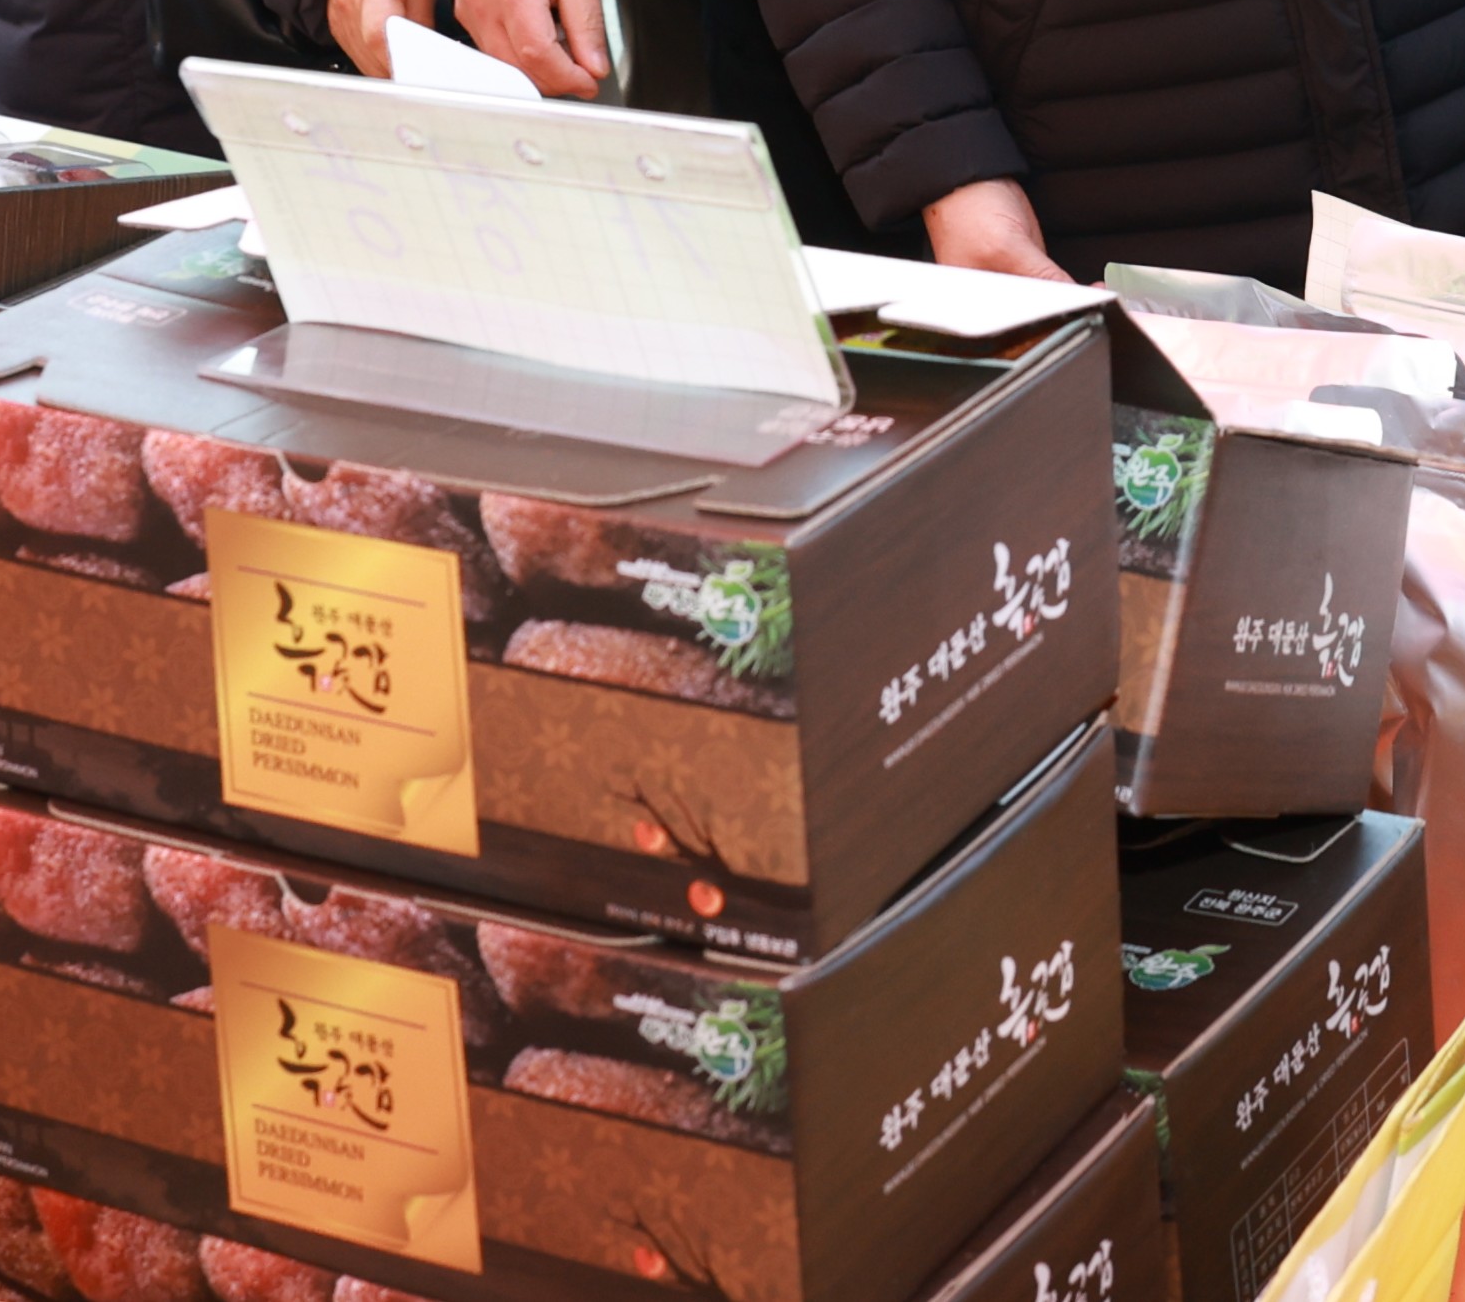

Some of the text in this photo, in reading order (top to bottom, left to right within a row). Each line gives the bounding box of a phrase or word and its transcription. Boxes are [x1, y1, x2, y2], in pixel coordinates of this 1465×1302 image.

[1233, 615, 1265, 654] 완주
[879, 662, 924, 726] 완주
[250, 728, 307, 756] DRIED
[252, 749, 361, 789] PERSIMMON
[879, 1087, 926, 1152] 완주
[1236, 1077, 1270, 1133] 완주
[256, 1138, 312, 1167] DRIED
[257, 1159, 365, 1203] PERSIMMON
